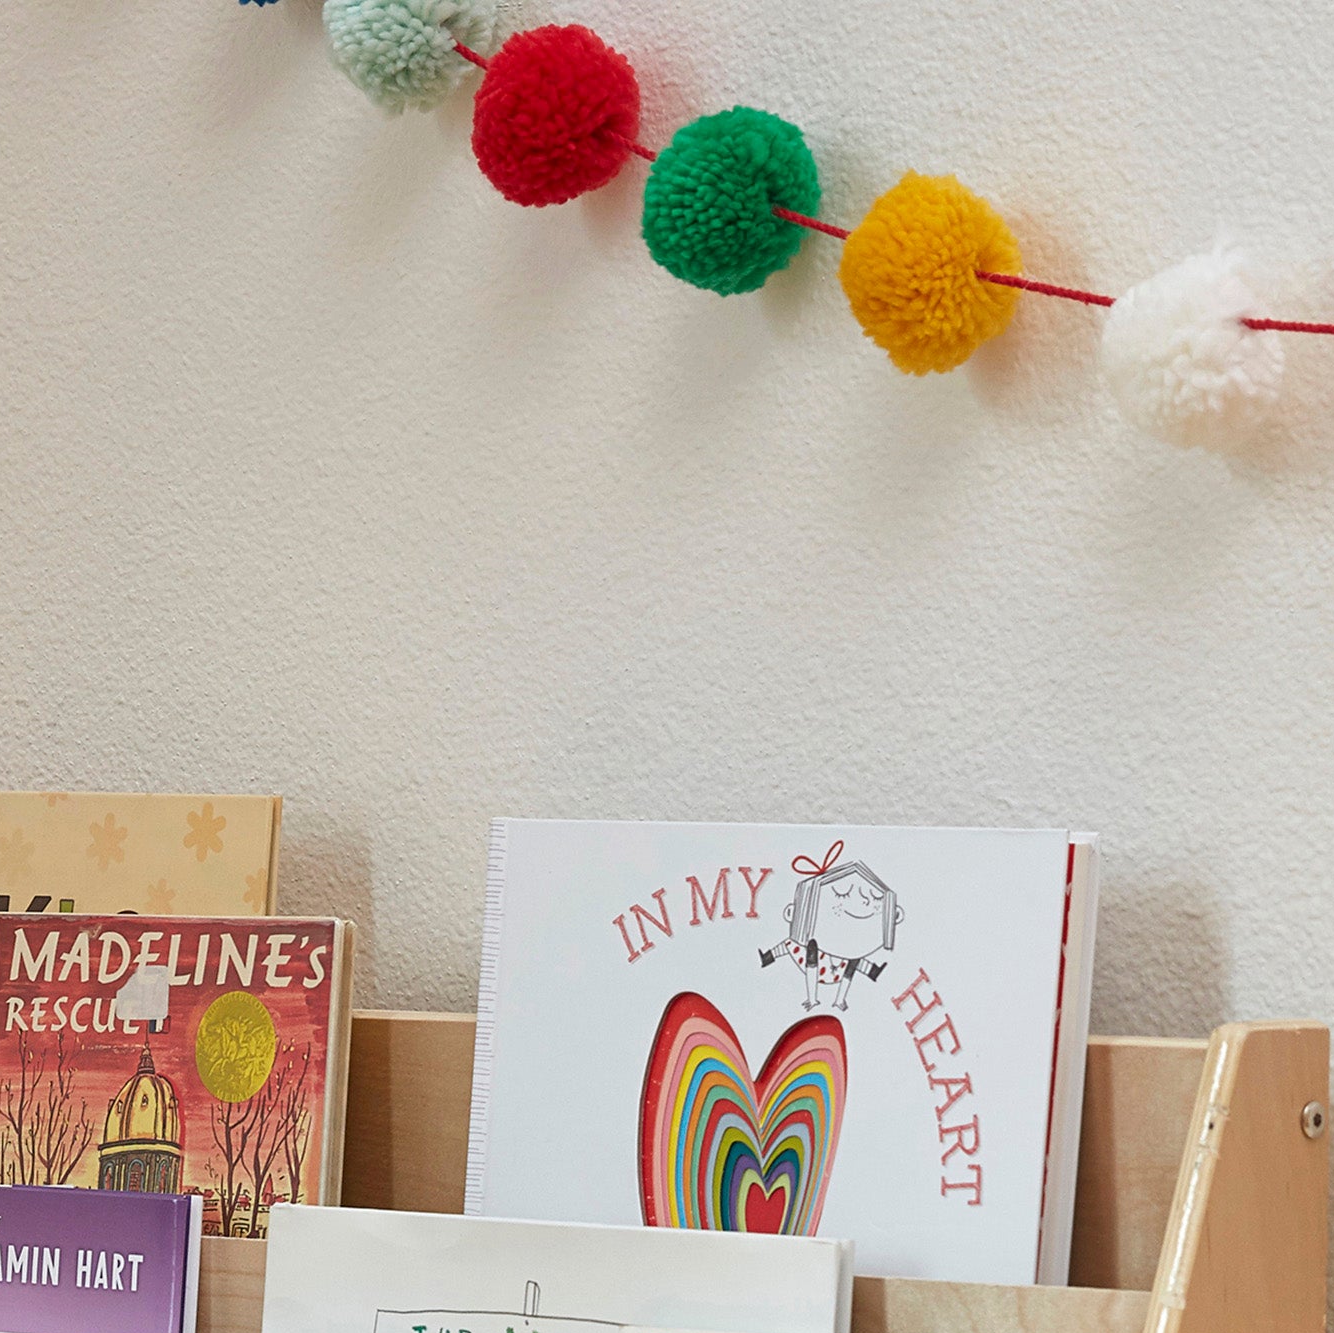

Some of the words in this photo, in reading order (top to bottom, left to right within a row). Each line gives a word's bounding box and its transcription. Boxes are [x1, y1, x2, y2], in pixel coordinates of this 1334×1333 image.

[612, 888, 674, 963] IN
[685, 866, 773, 926] MY
[4, 996, 141, 1035] RESCU
[890, 967, 984, 1207] HEART
[75, 1249, 145, 1292] HART
